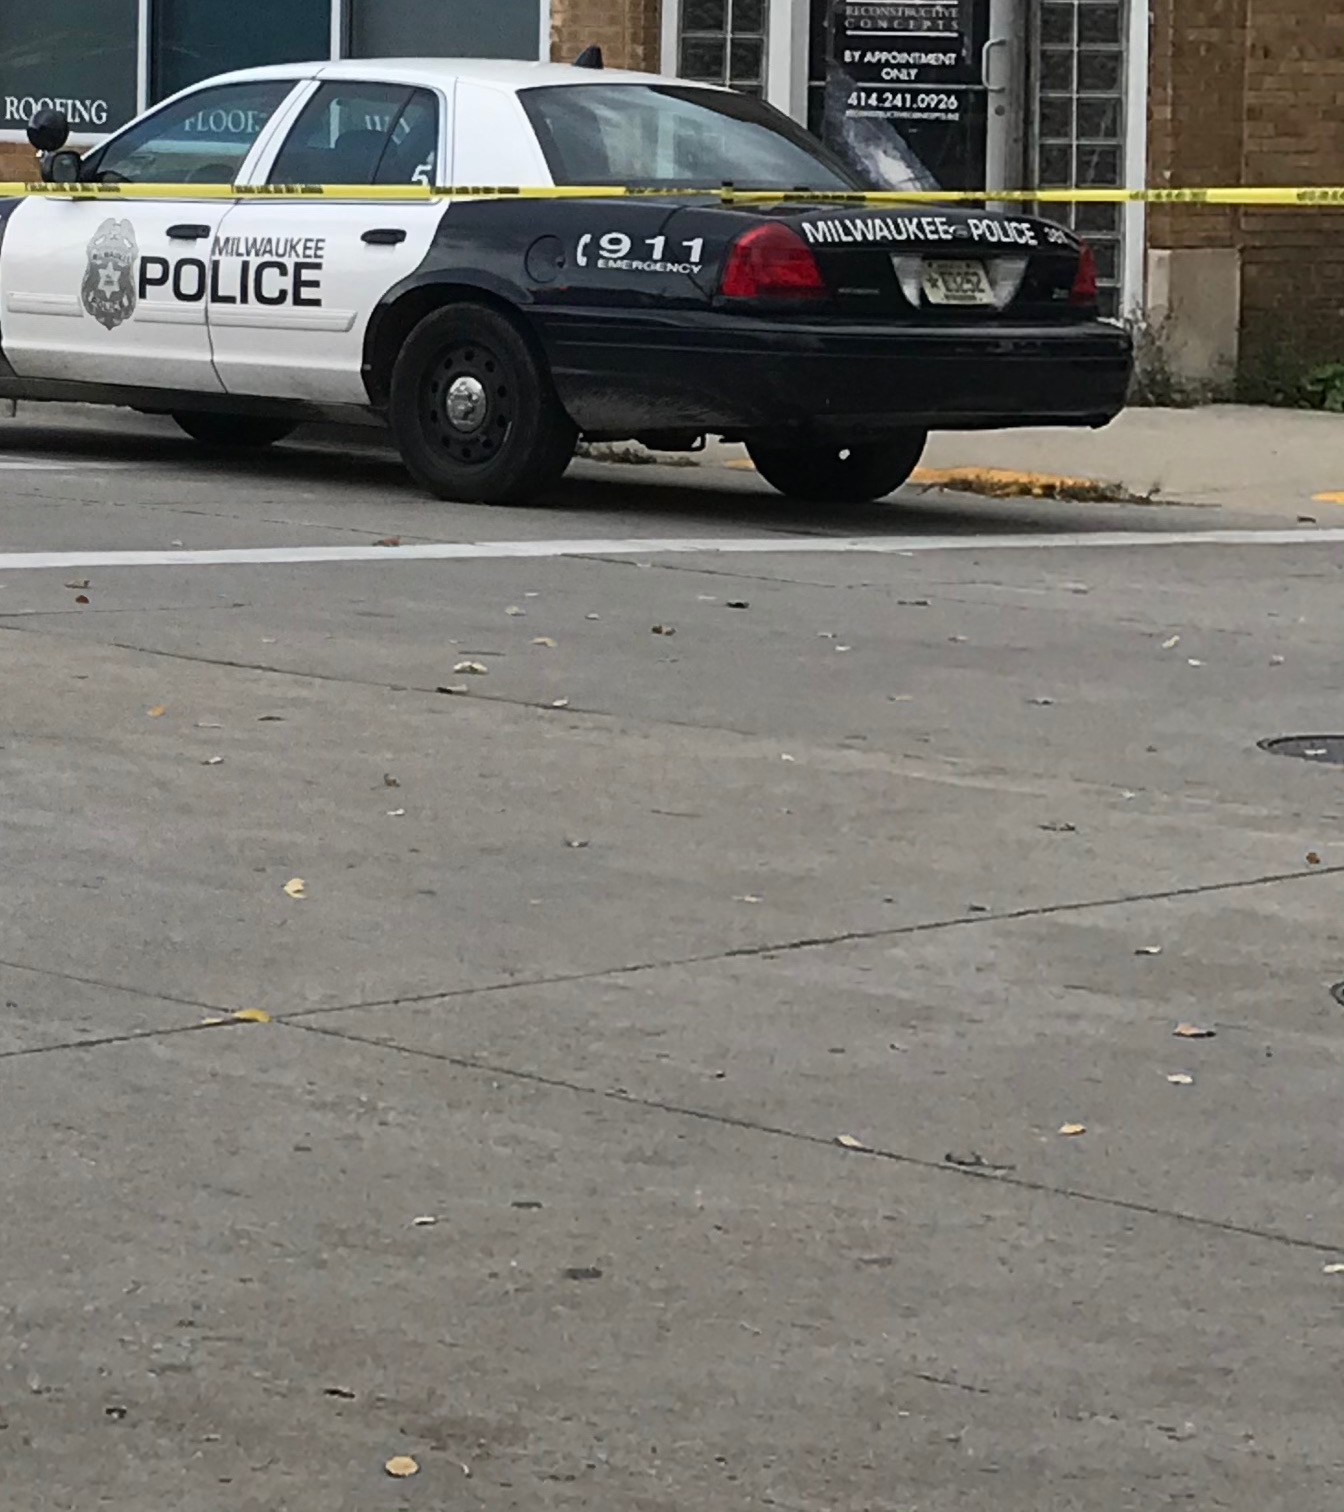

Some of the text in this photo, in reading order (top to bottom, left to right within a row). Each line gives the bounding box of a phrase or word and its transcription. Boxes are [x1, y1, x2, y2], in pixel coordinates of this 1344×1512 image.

[845, 5, 959, 18] RECONSTRUCTIVE
[845, 18, 959, 30] CONCEPTS
[844, 50, 957, 65] BY APPOINTMENT
[881, 68, 918, 80] ONLY
[847, 91, 958, 109] 414.241.0926
[802, 217, 953, 243] MILWAUKEE
[967, 219, 1038, 246] POLICE
[212, 236, 325, 259] MILWAUKEE
[599, 232, 703, 262] 911
[597, 258, 702, 274] EMERGENCY
[139, 256, 323, 307] POLICE
